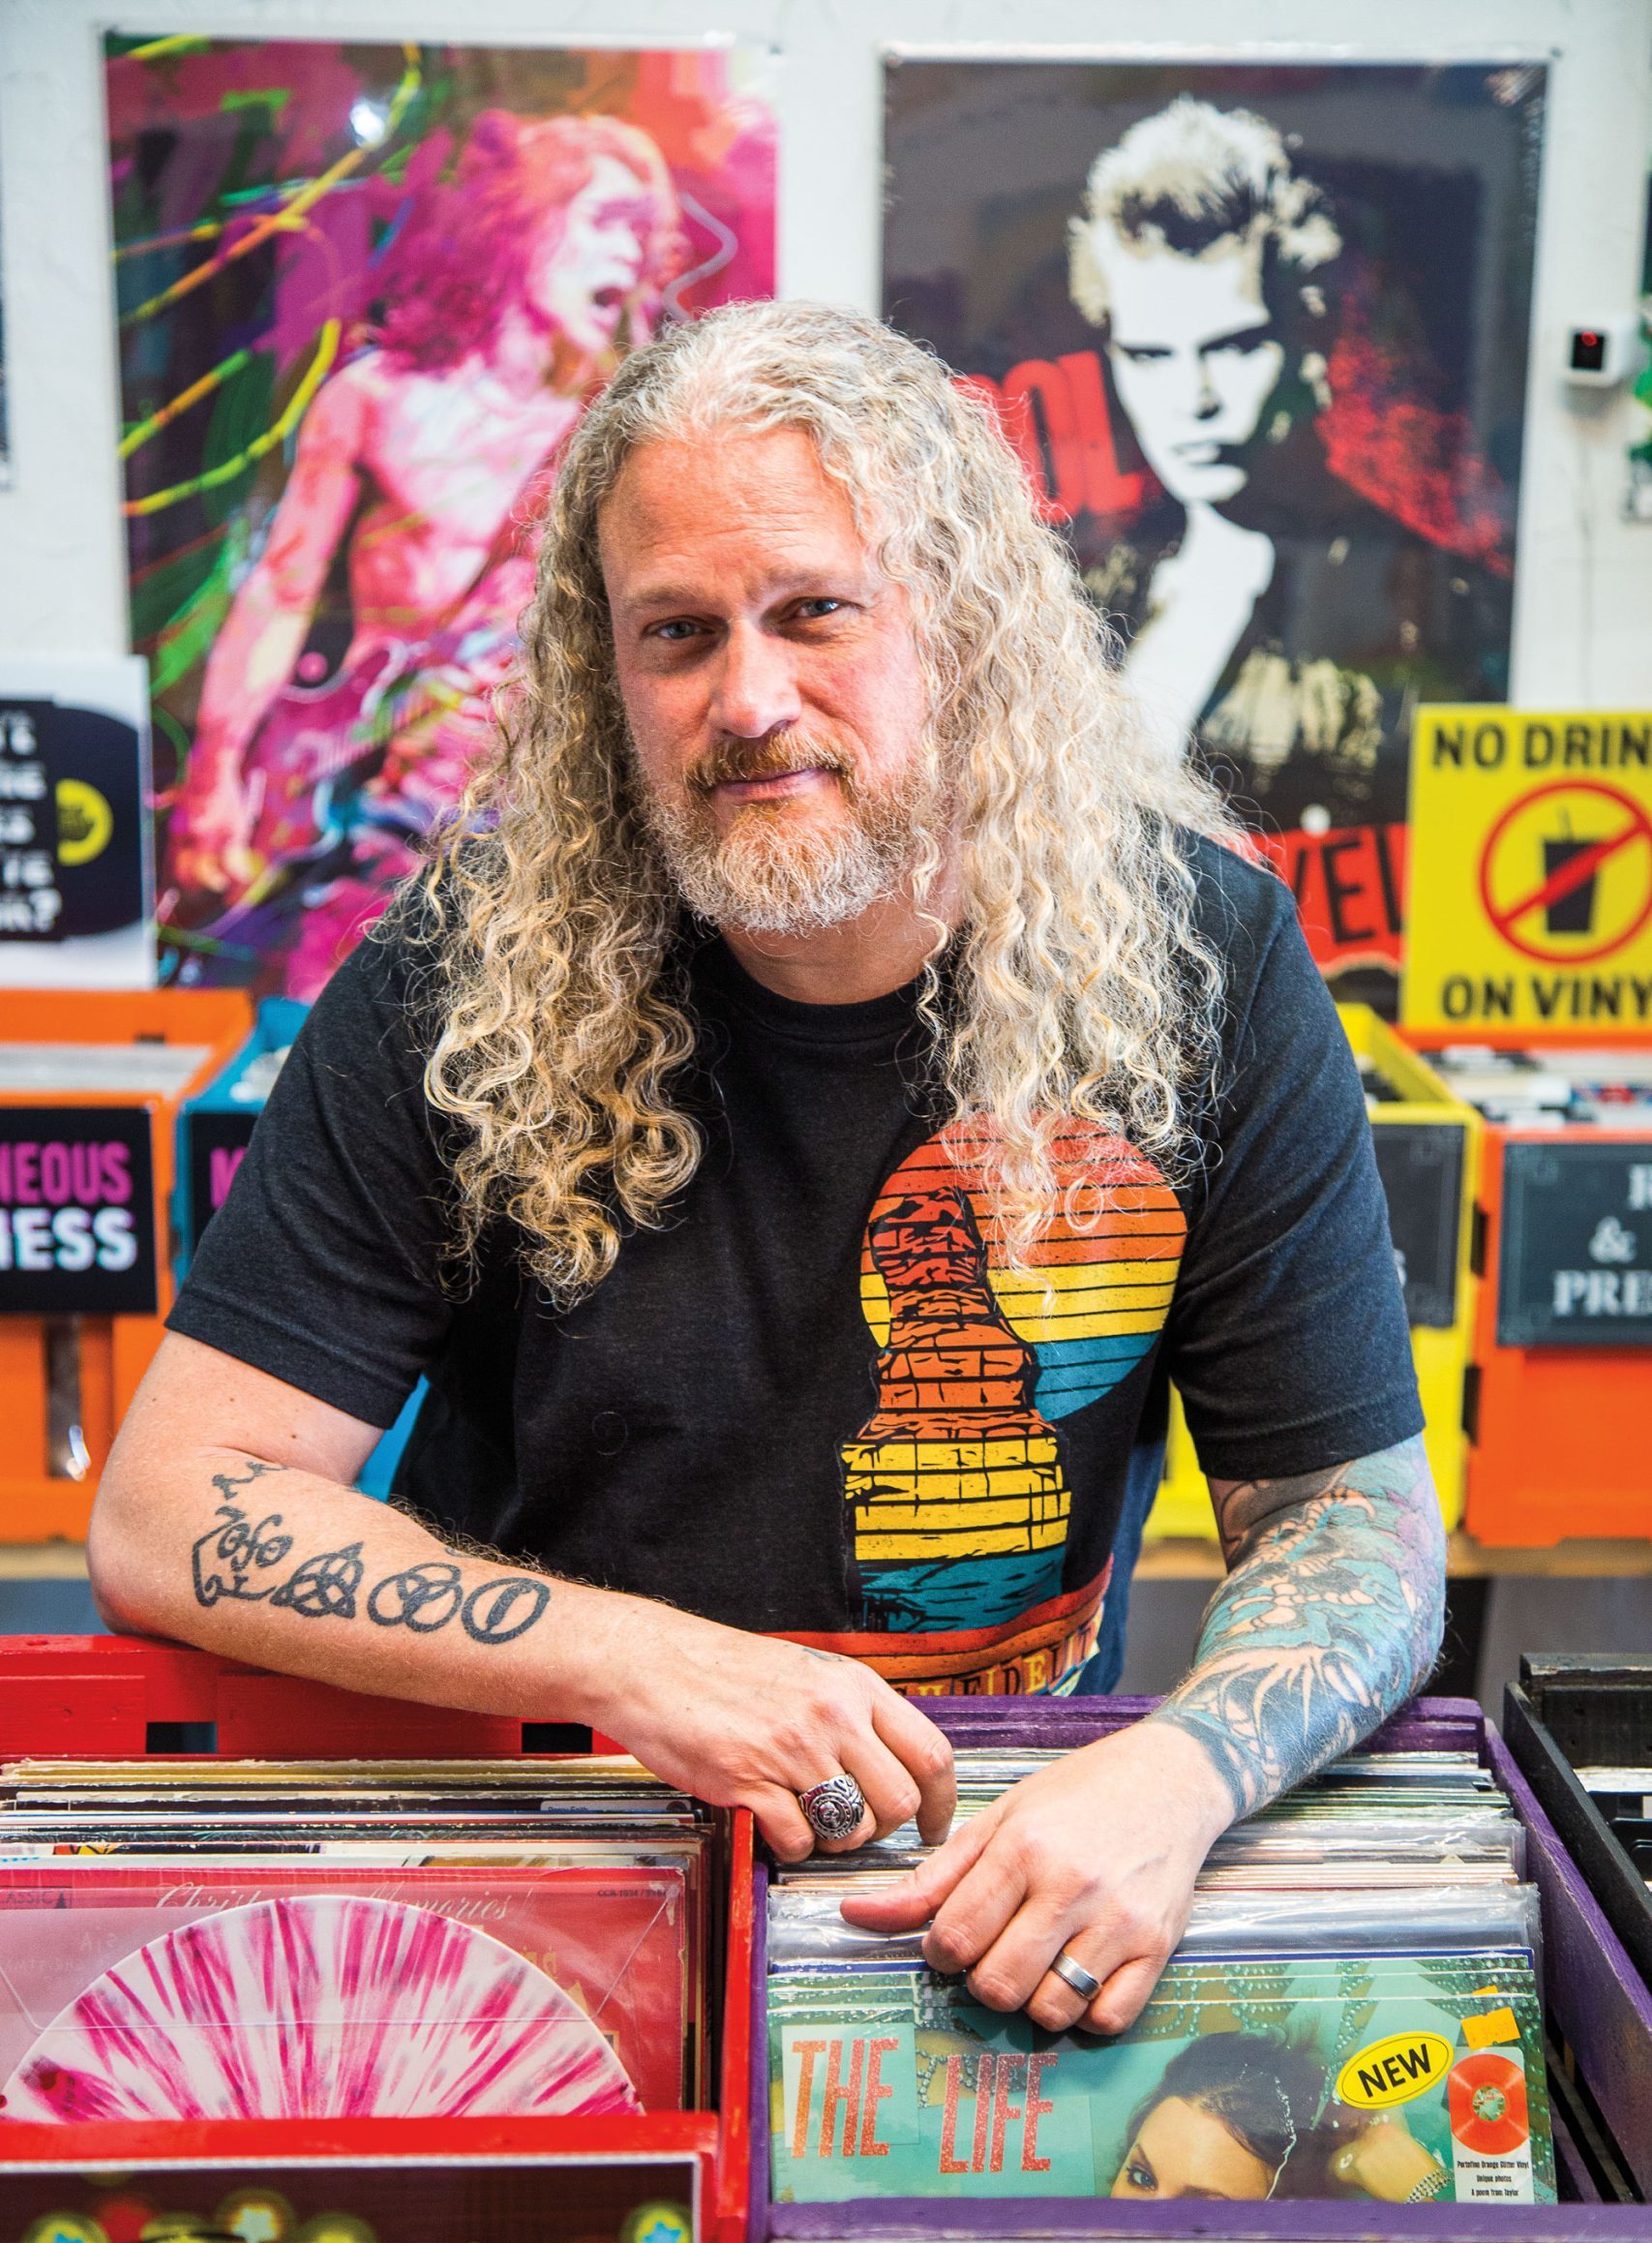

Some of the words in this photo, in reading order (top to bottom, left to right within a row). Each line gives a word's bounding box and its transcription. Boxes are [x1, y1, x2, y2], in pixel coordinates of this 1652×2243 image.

[951, 350, 1144, 521] OL
[1433, 722, 1506, 769] NO
[1523, 722, 1652, 769] DRIN
[1441, 974, 1514, 1019] ON
[1531, 975, 1652, 1019] VINY
[1589, 1216, 1636, 1263] &
[0, 1891, 54, 1905] ASSIC
[1357, 2043, 1431, 2098] NEW
[791, 2037, 899, 2158] THE
[939, 2052, 1058, 2174] LIFE
